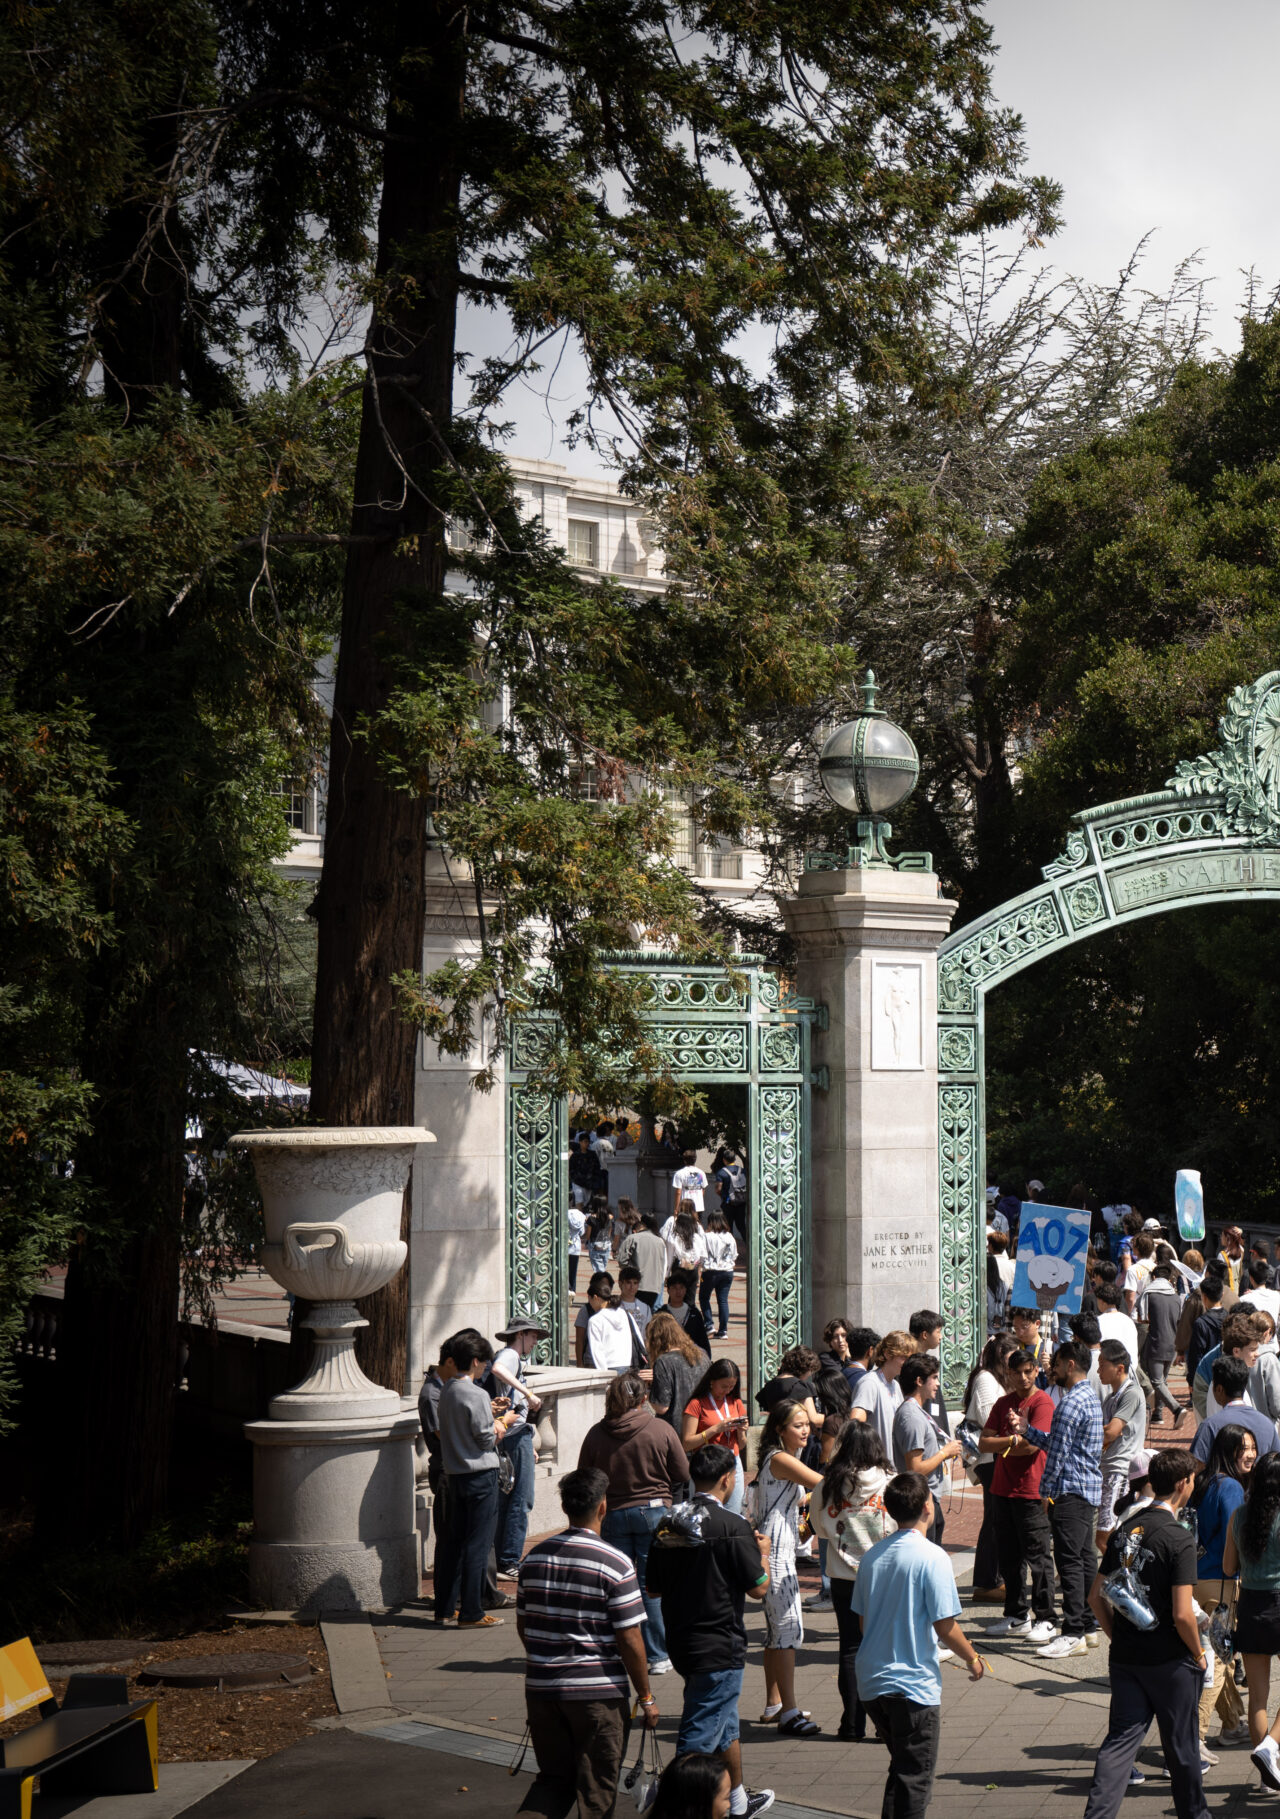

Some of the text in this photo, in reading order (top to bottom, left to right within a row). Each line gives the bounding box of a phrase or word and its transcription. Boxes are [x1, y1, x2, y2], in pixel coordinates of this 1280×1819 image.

[874, 1231, 924, 1240] ERECTED BY
[863, 1246, 886, 1256] JANE
[900, 1244, 934, 1255] SATHER
